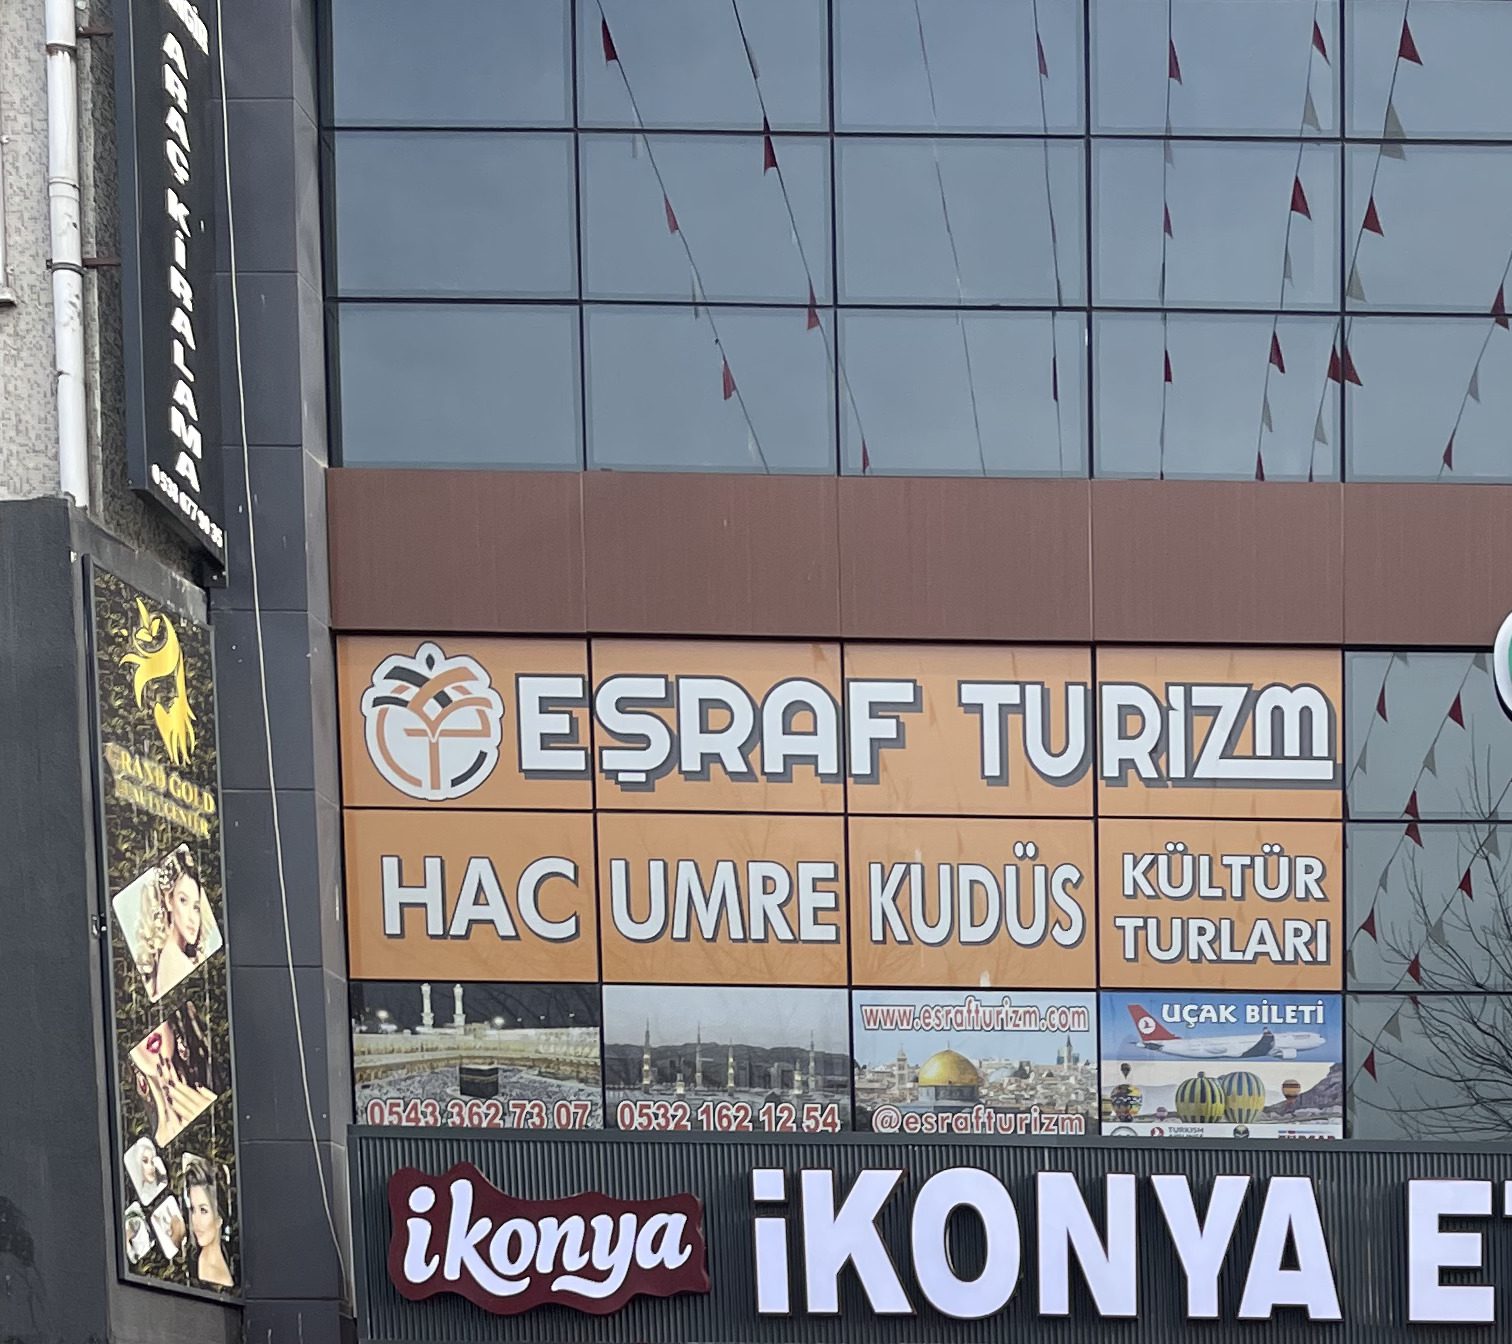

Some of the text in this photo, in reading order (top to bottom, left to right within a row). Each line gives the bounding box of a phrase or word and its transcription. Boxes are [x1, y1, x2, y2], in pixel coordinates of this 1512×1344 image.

[162, 32, 202, 493] ARAÇ KİRALAMA
[515, 674, 922, 791] EŞRAF
[169, 774, 216, 813] GOLD
[380, 841, 1328, 947] HAC UMRE KUDÜS KÜLTÜR
[1114, 915, 1331, 965] TURLARI
[860, 995, 1089, 1032] www.esrafturizm.com
[1161, 998, 1326, 1029] UÇAK BİLETİ
[366, 1098, 590, 1129] 0543 362 73 07
[616, 1100, 839, 1132] 0532 162 12 54
[872, 1103, 1086, 1134] @esrafturizm
[403, 1179, 692, 1299] ikonya
